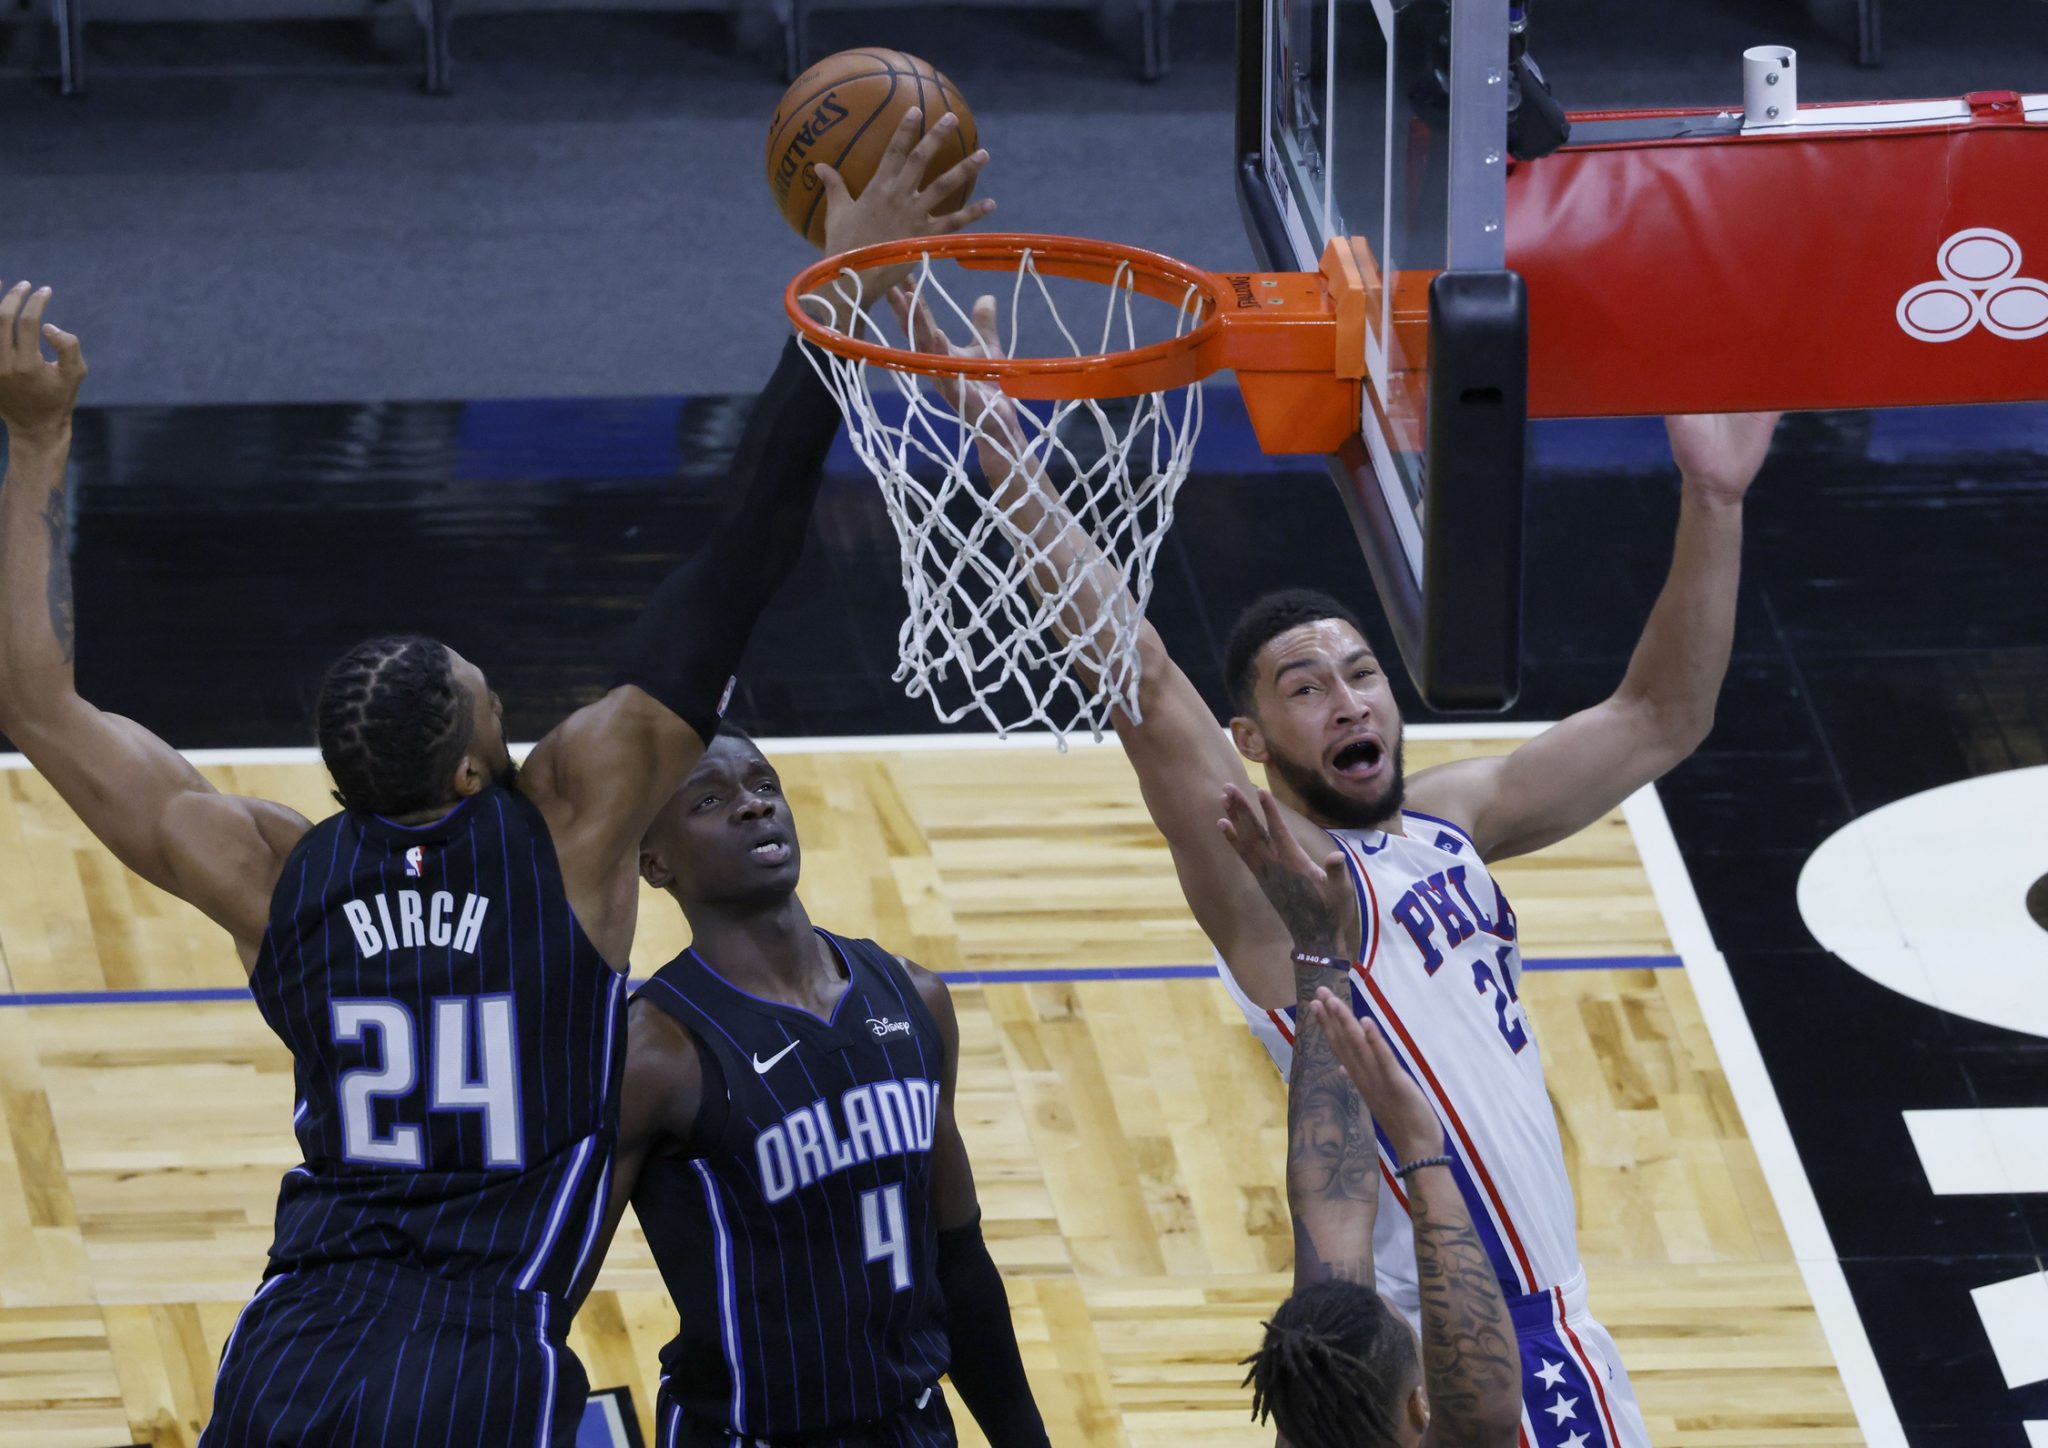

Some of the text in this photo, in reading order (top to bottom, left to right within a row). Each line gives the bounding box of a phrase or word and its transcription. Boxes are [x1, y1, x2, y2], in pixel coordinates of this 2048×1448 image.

[775, 91, 849, 200] SPALDI
[342, 889, 489, 959] BIRCH
[328, 991, 525, 1170] 24
[859, 1181, 913, 1293] 4
